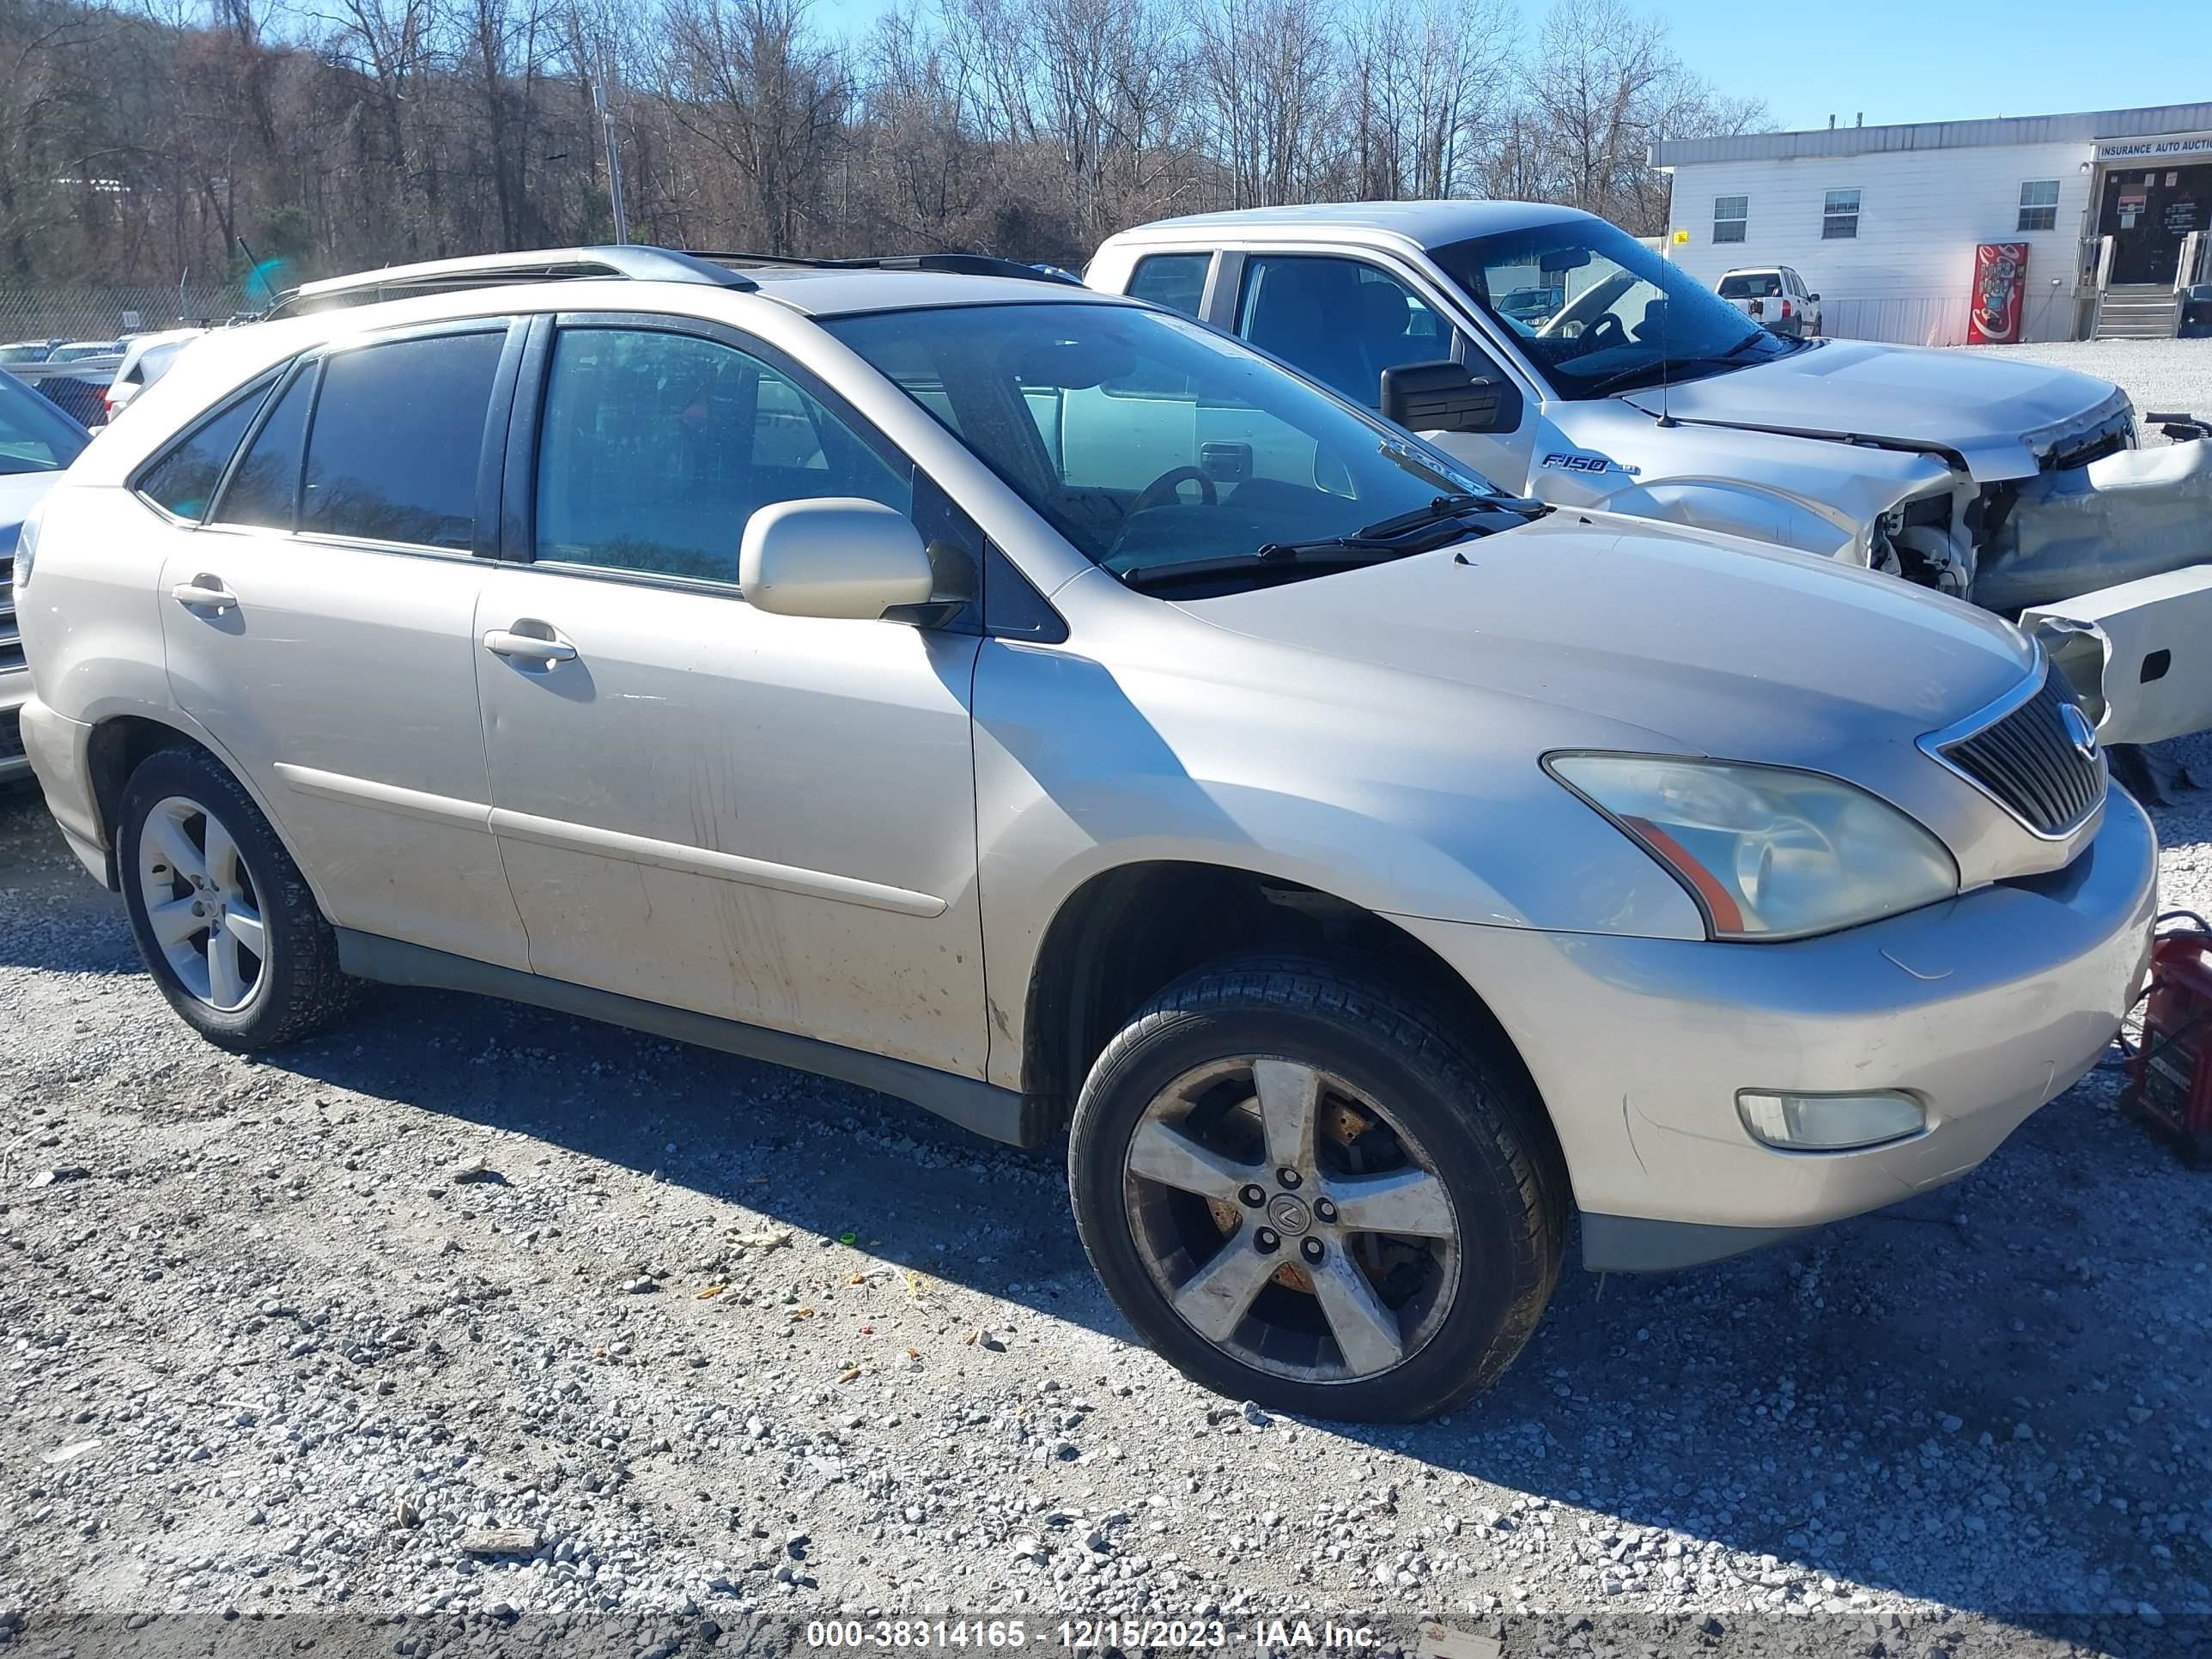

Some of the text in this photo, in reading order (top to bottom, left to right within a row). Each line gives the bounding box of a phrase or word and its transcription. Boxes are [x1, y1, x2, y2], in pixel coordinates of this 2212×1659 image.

[2101, 144, 2152, 156] INSURANCE
[2155, 142, 2180, 153] AUTO
[1540, 453, 1610, 474] F-150
